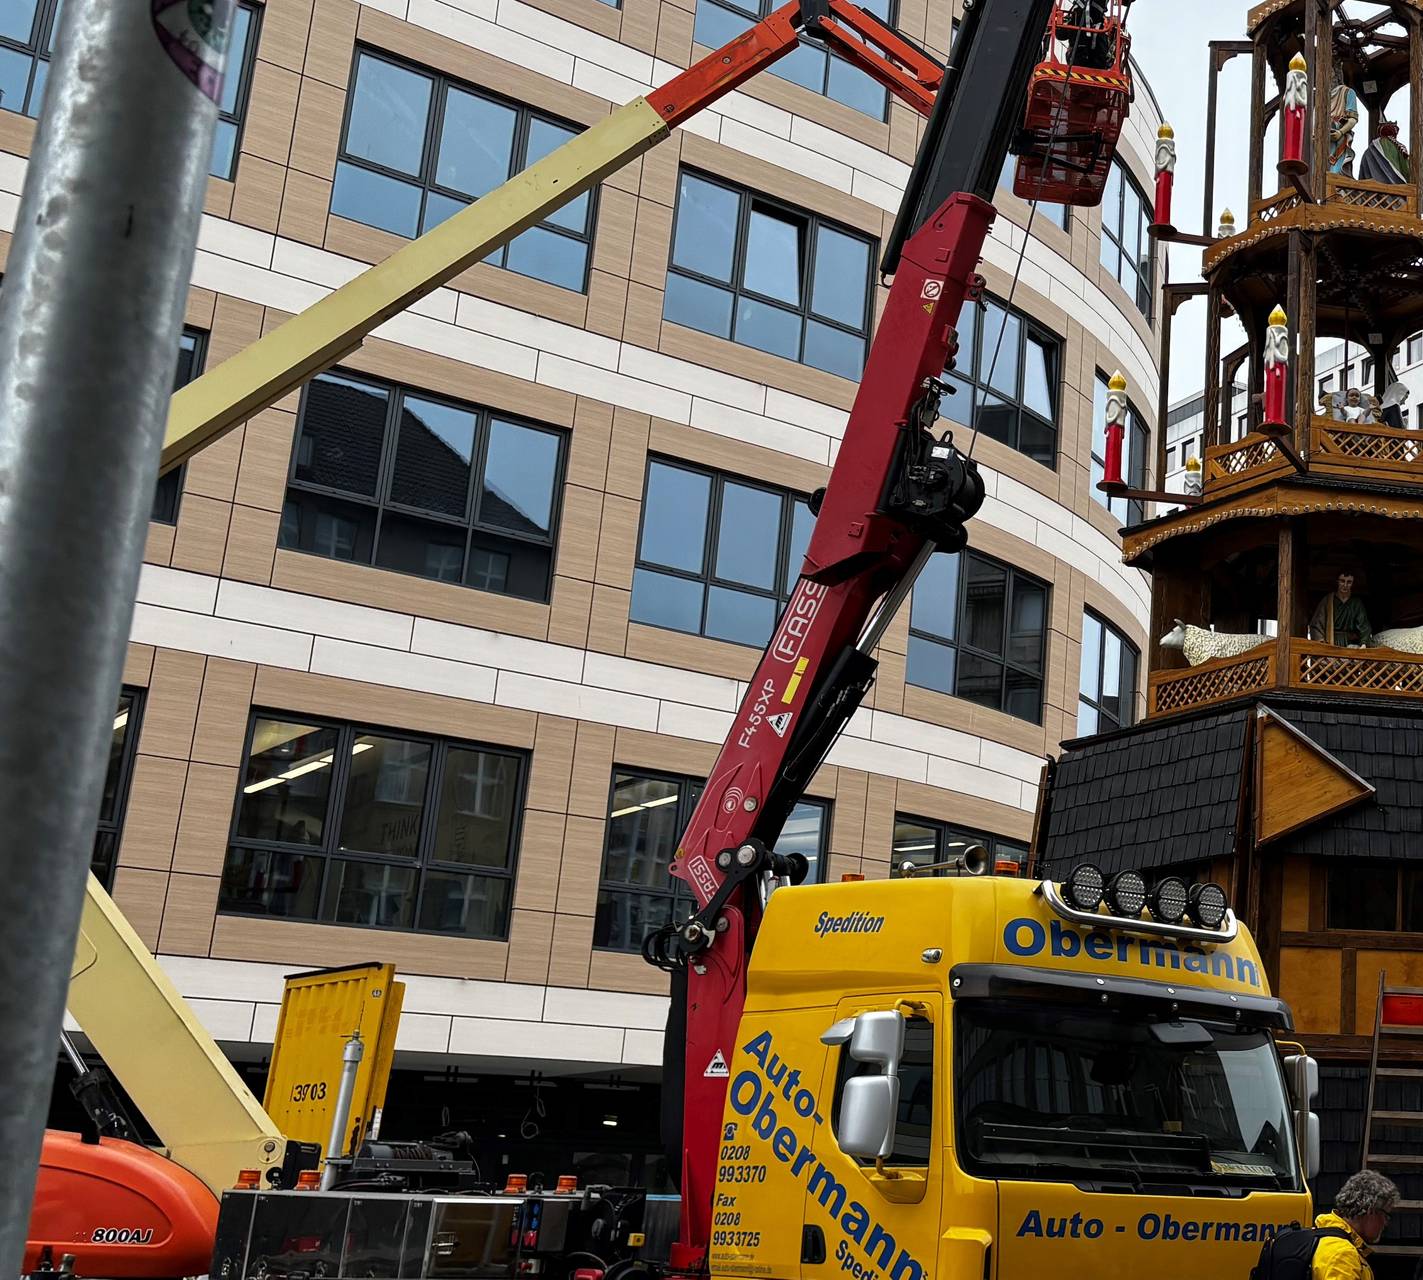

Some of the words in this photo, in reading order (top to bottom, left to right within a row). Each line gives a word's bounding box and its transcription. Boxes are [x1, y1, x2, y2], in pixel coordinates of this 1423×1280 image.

[738, 678, 776, 749] F455XP
[814, 911, 885, 938] Spedition
[1002, 917, 1258, 987] Obermann
[742, 1030, 824, 1126] Auto-
[720, 1145, 751, 1160] 0208
[718, 1165, 767, 1183] 993370
[730, 1070, 923, 1280] Obermann
[716, 1193, 736, 1207] Fax
[714, 1212, 741, 1226] 0208
[1016, 1210, 1104, 1239] Auto
[91, 1227, 154, 1244] 800AJ
[713, 1230, 761, 1248] 9933725
